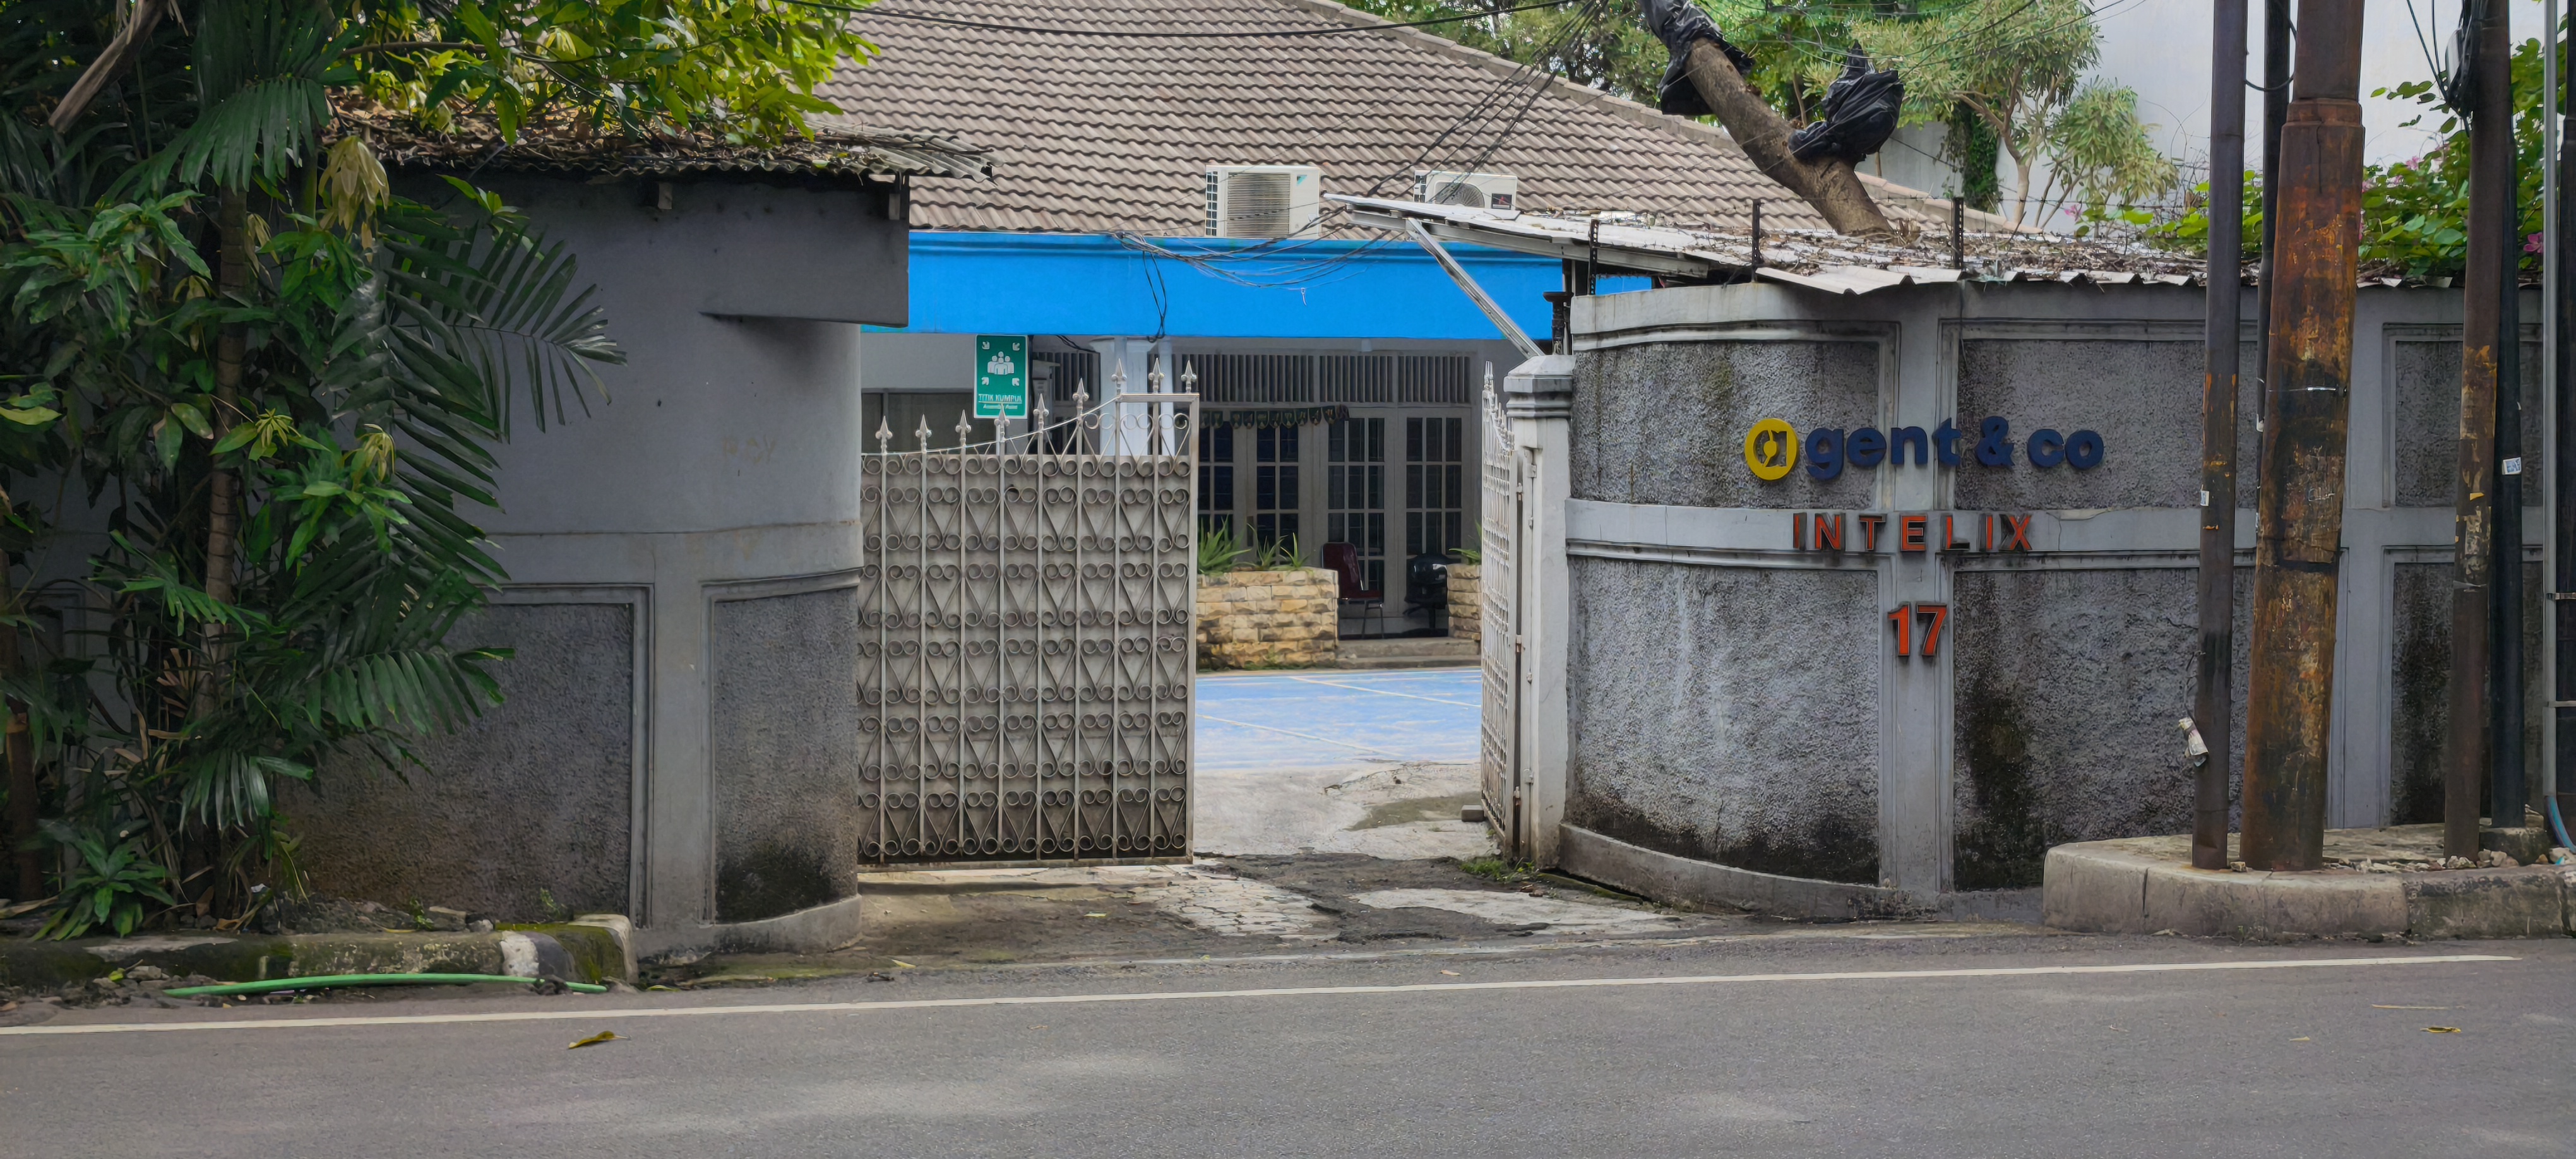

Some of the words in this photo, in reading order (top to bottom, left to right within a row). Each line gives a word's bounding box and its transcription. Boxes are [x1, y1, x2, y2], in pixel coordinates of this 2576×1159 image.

[978, 393, 994, 401] TITIK
[1744, 418, 1961, 480] agent
[1975, 416, 2014, 467] &
[2027, 429, 2104, 470] co
[1792, 512, 2032, 552] INTELIX
[1887, 603, 1947, 657] 17
